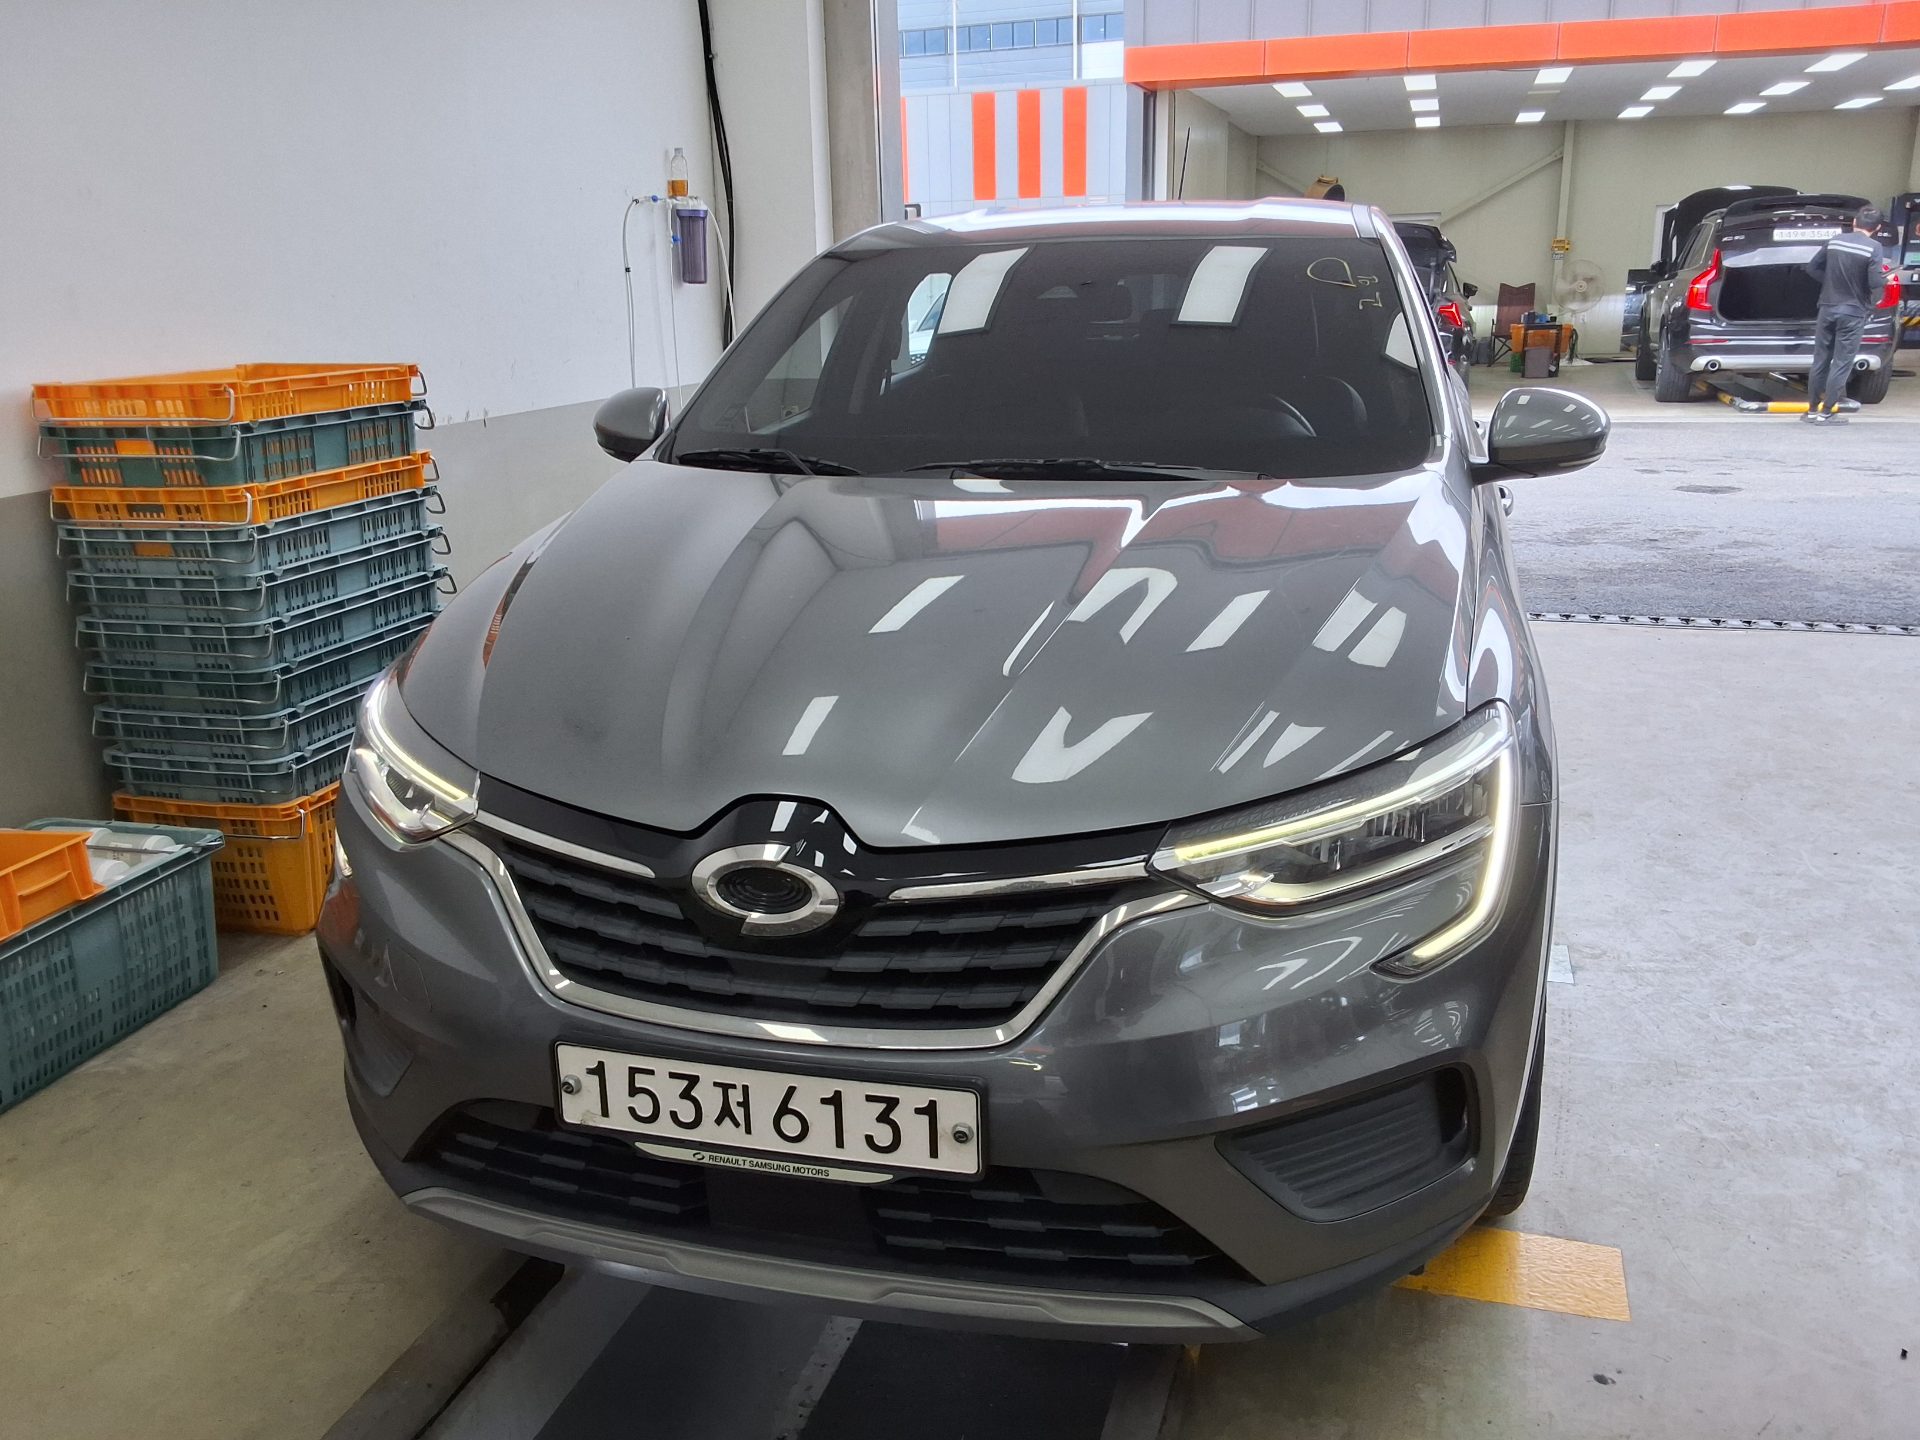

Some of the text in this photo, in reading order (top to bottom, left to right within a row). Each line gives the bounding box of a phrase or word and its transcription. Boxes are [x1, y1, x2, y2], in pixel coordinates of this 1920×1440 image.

[708, 1154, 830, 1177] RENAULT SAMSUNG MOTORS
